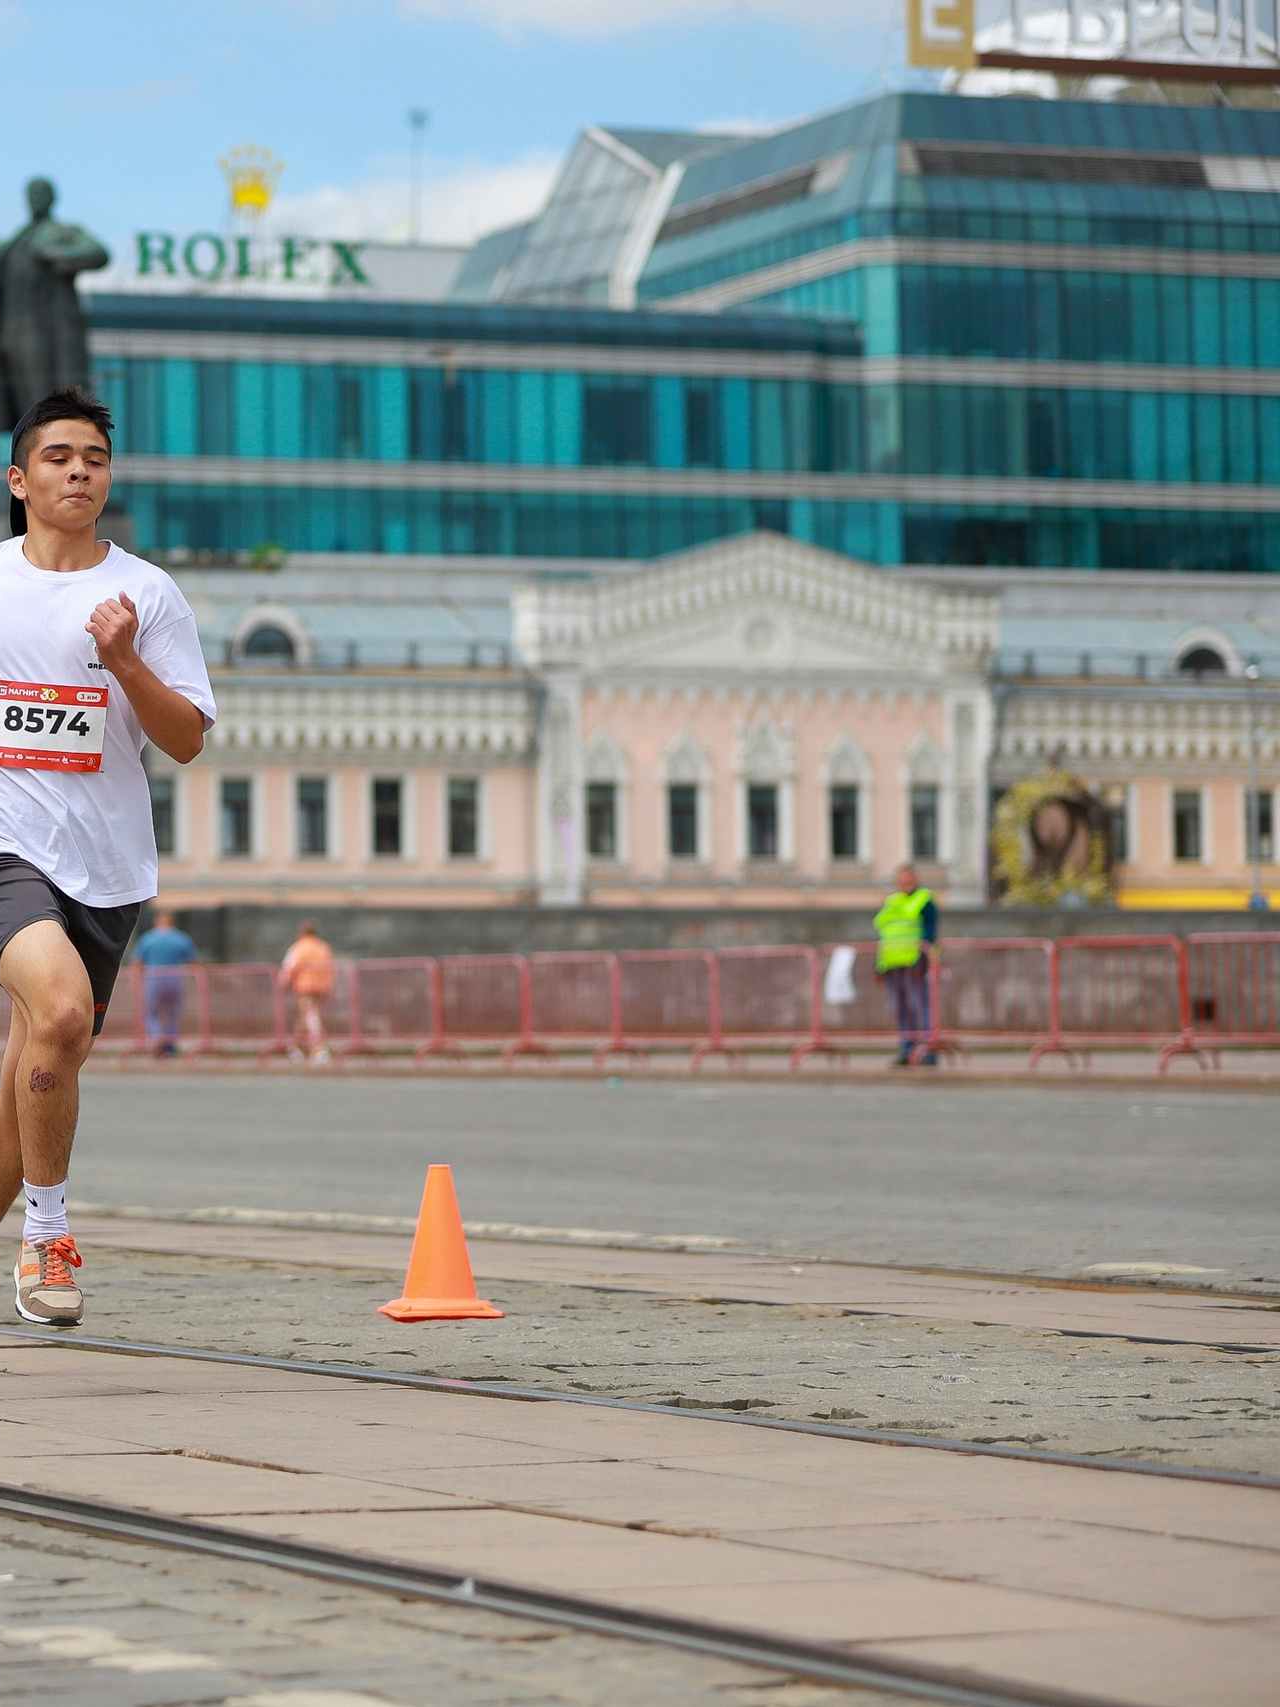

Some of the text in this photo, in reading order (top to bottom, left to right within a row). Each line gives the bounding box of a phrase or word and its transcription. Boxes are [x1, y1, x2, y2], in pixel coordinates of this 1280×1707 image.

[136, 231, 372, 286] ROLEX
[8, 688, 39, 698] МАГНИТ
[3, 705, 90, 737] 8574
